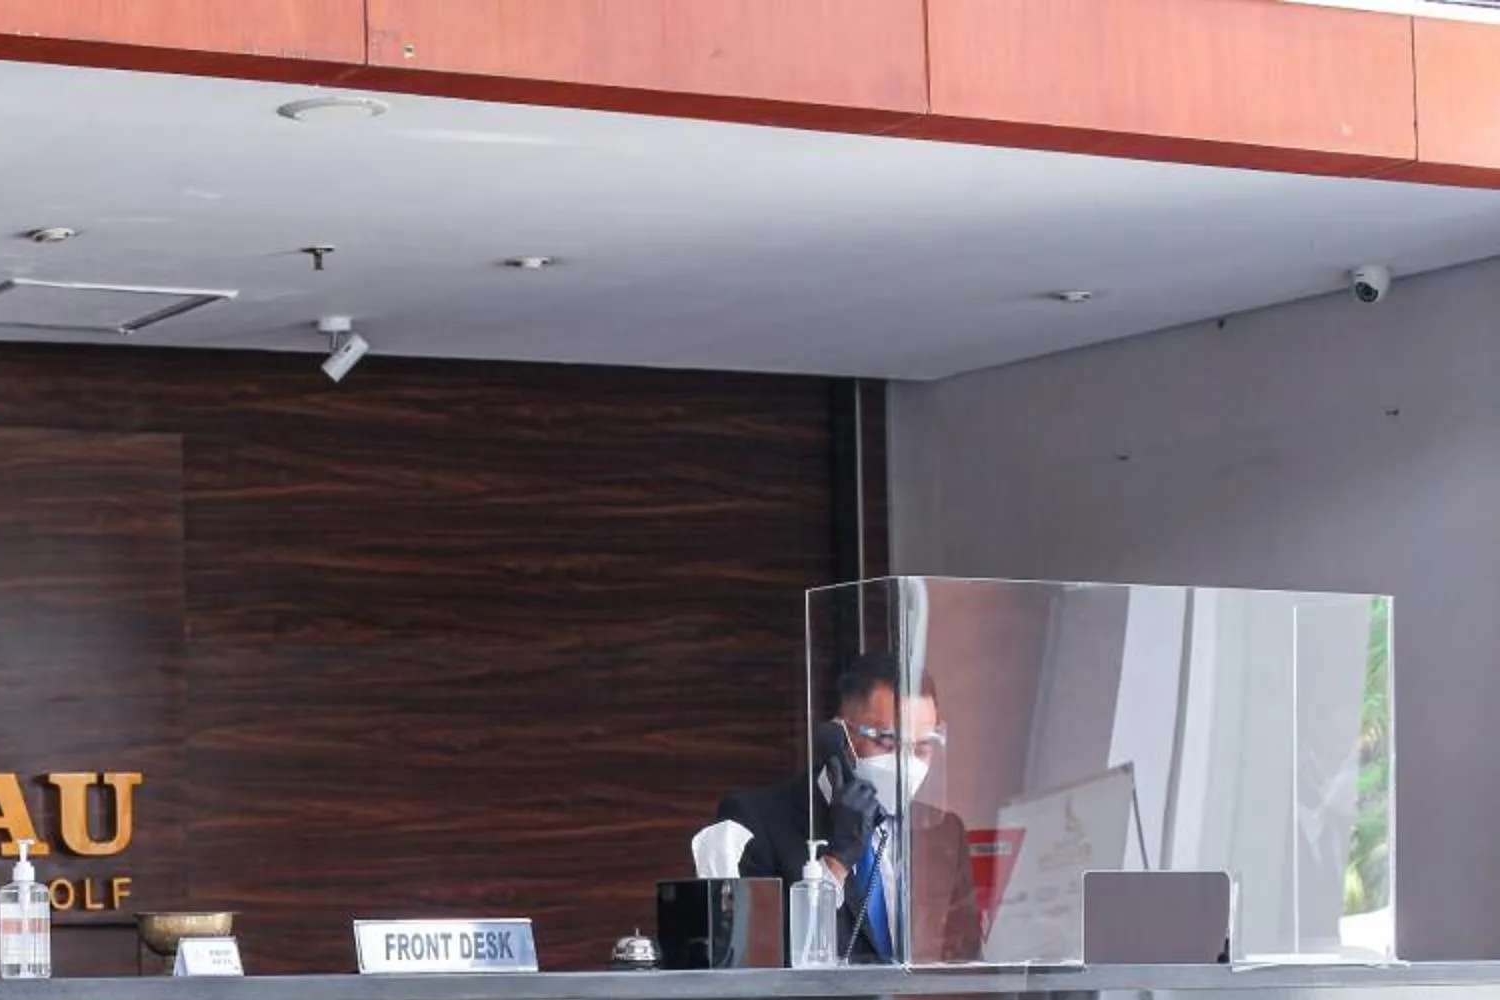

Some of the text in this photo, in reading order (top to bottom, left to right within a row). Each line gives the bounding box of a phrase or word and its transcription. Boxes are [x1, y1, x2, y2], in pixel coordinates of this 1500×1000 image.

[48, 877, 133, 911] OLF
[385, 931, 514, 962] FRONT DESK
